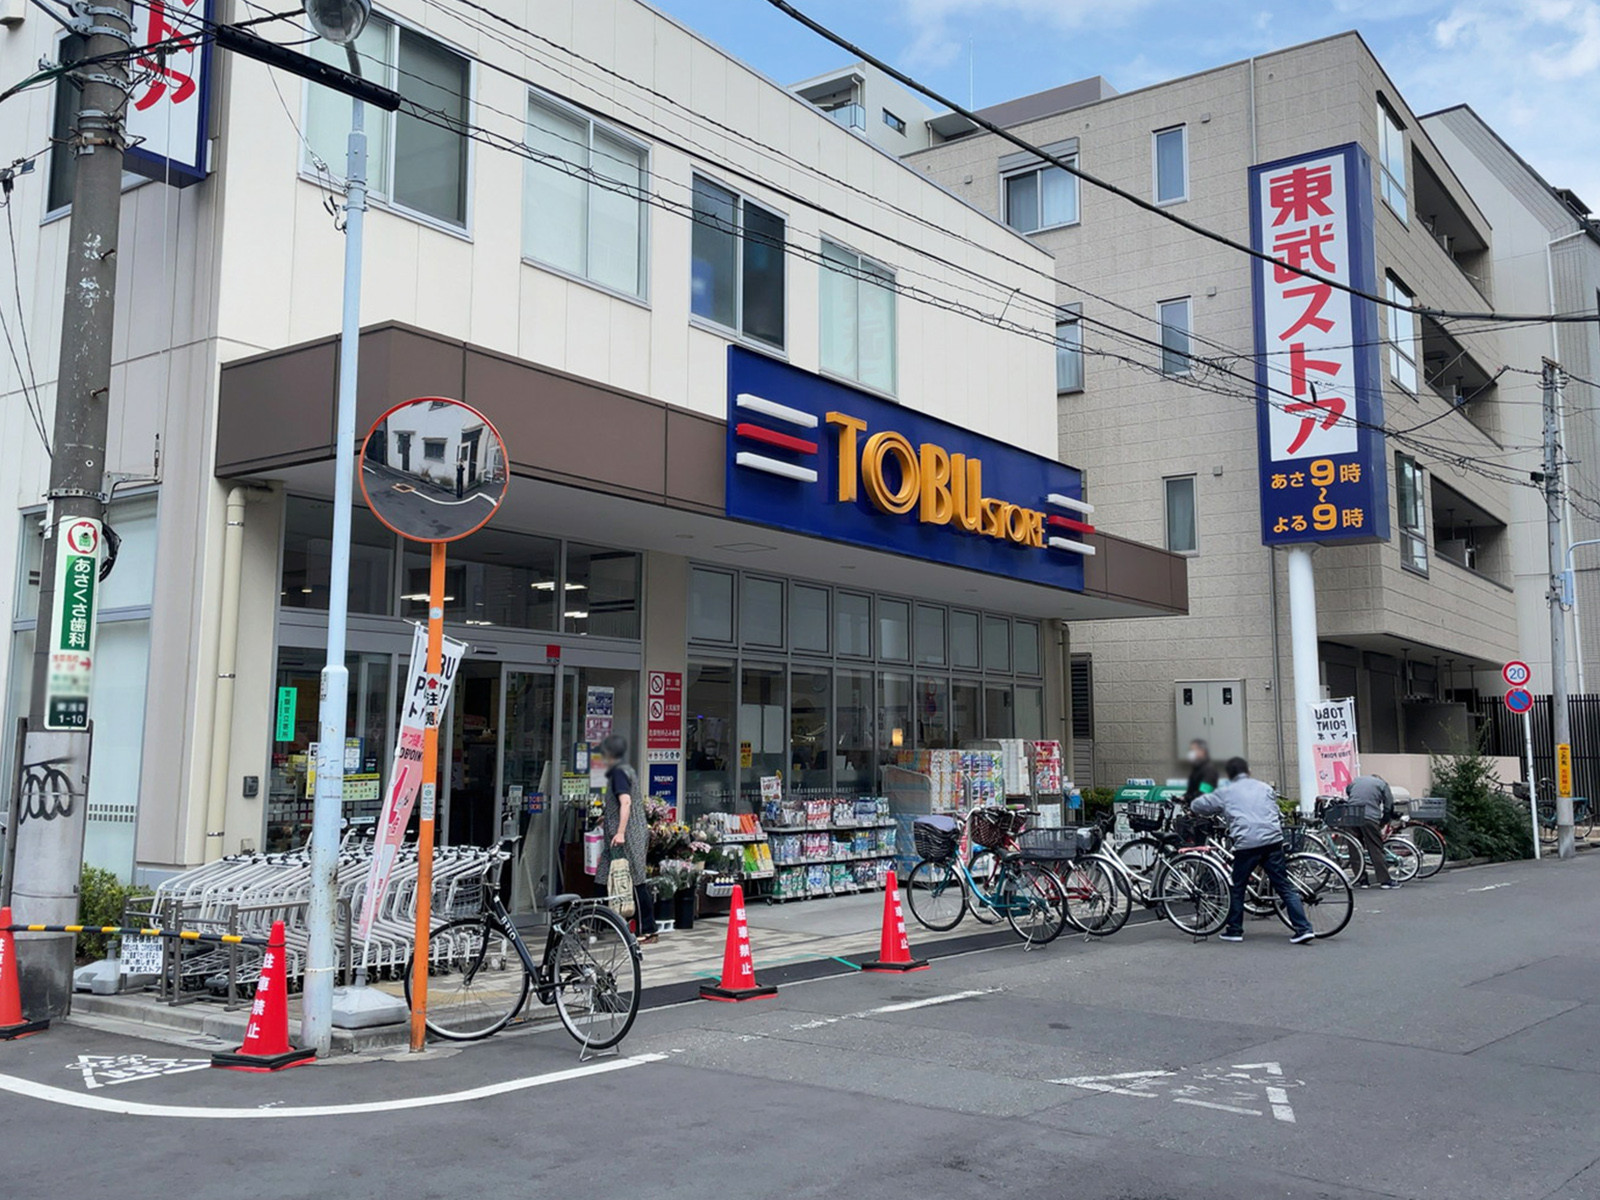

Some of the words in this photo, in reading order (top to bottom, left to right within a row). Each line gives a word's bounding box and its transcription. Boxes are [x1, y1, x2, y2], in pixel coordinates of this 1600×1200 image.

[134, 0, 198, 111] トア
[1269, 164, 1347, 455] 東武ストア
[826, 411, 982, 536] TOBU
[980, 497, 1048, 549] STORE
[1271, 458, 1361, 490] あさ9時
[1273, 503, 1364, 534] よる9時
[68, 558, 91, 648] あさくさ歯科
[1508, 667, 1525, 680] 20
[58, 714, 84, 724] 1-10
